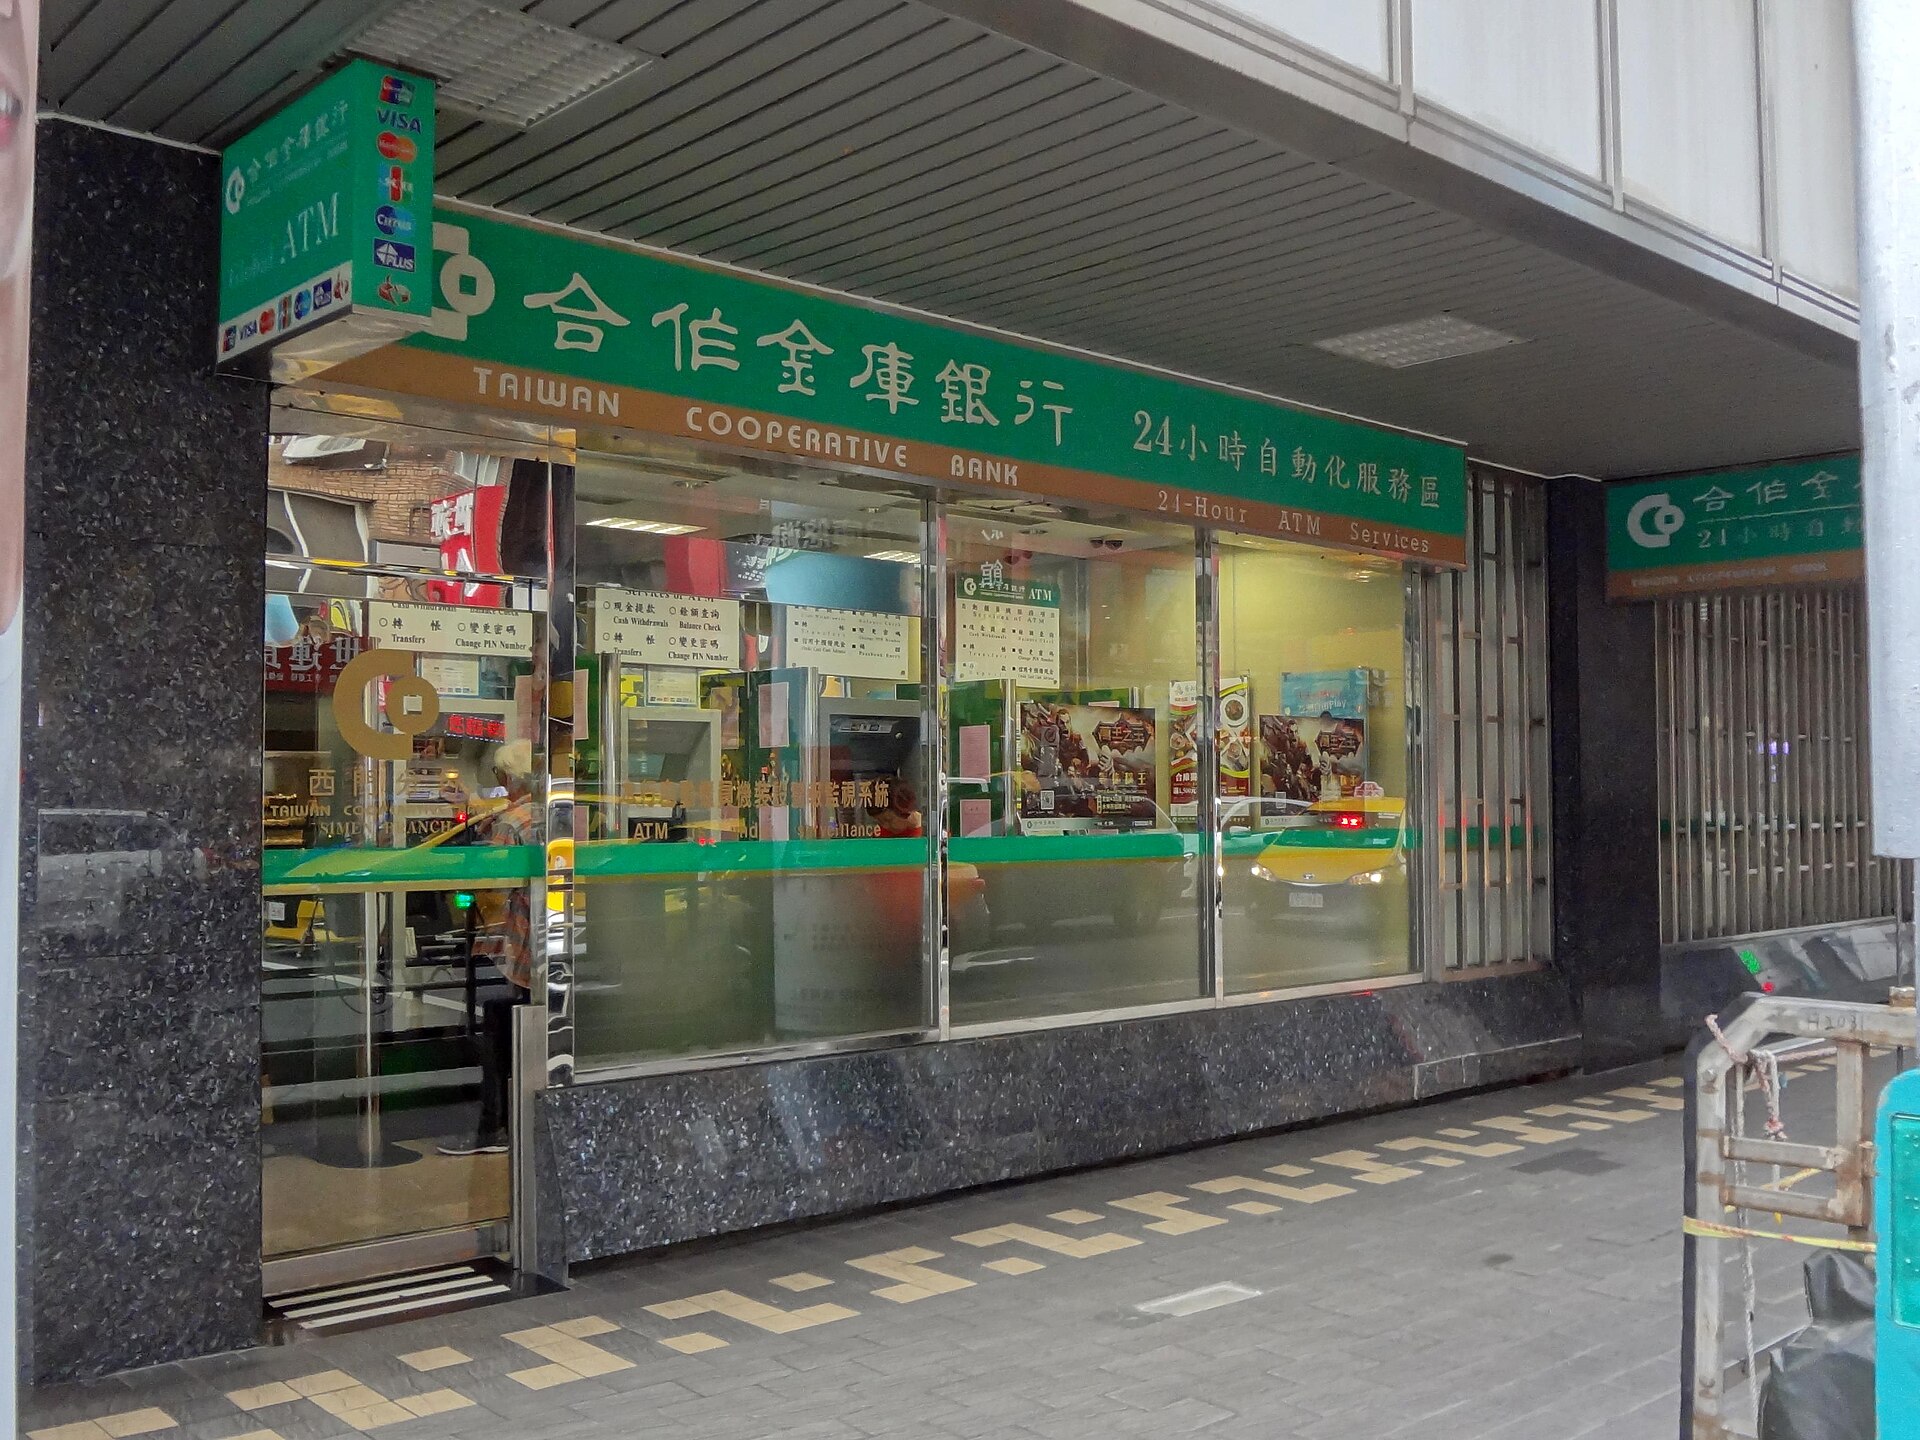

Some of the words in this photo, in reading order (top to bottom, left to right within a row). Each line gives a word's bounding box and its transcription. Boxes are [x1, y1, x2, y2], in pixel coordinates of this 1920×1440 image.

[376, 108, 421, 135] VISA
[281, 192, 339, 264] ATM
[473, 367, 619, 417] TAIWAN
[686, 407, 907, 468] COOPERATIVE
[951, 454, 1018, 486] BANK
[1133, 410, 1440, 508] 24小時自動化服務區
[1278, 510, 1321, 535] ATM
[1350, 522, 1429, 552] Services
[1028, 588, 1052, 601] ATM
[613, 602, 655, 614] 現金提款
[613, 616, 629, 624] Cash
[631, 617, 669, 628] Withdrawals
[679, 621, 702, 630] Balance
[703, 622, 721, 632] Check
[470, 623, 516, 636] 變更密碼
[391, 634, 426, 644] Transfers
[455, 638, 482, 648] Change
[484, 639, 497, 648] PIN
[500, 641, 527, 650] Number
[679, 636, 720, 649] 變更密碼
[668, 651, 690, 660] Change
[692, 652, 704, 660] PIN
[705, 652, 728, 661] Number
[271, 805, 330, 817] TAIWAN
[385, 820, 452, 835] BANCH
[634, 822, 668, 840] ATM
